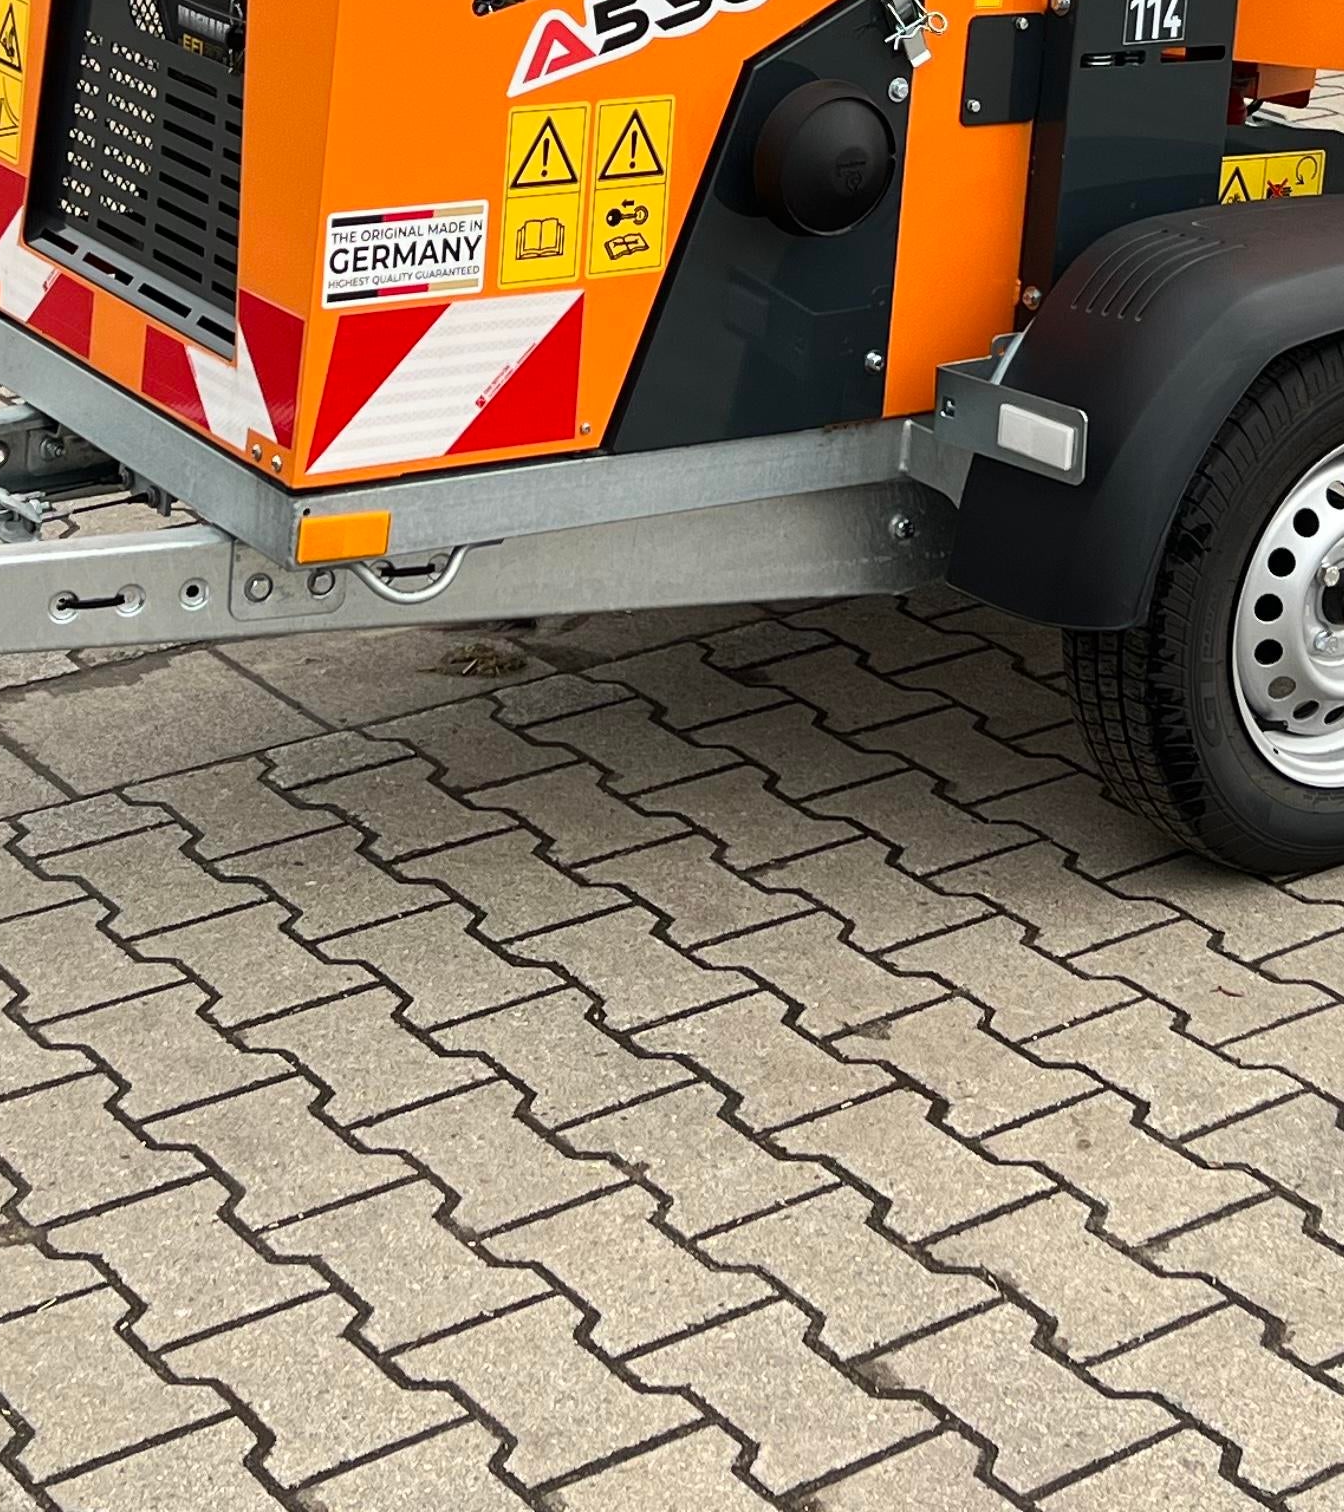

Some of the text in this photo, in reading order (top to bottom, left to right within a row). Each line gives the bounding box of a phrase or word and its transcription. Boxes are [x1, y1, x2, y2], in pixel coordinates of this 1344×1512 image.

[332, 219, 484, 244] THE ORIGINAL MADE IN
[329, 234, 483, 274] GERMANY
[328, 265, 480, 289] HIGHEST QUALITY GUARANTEED
